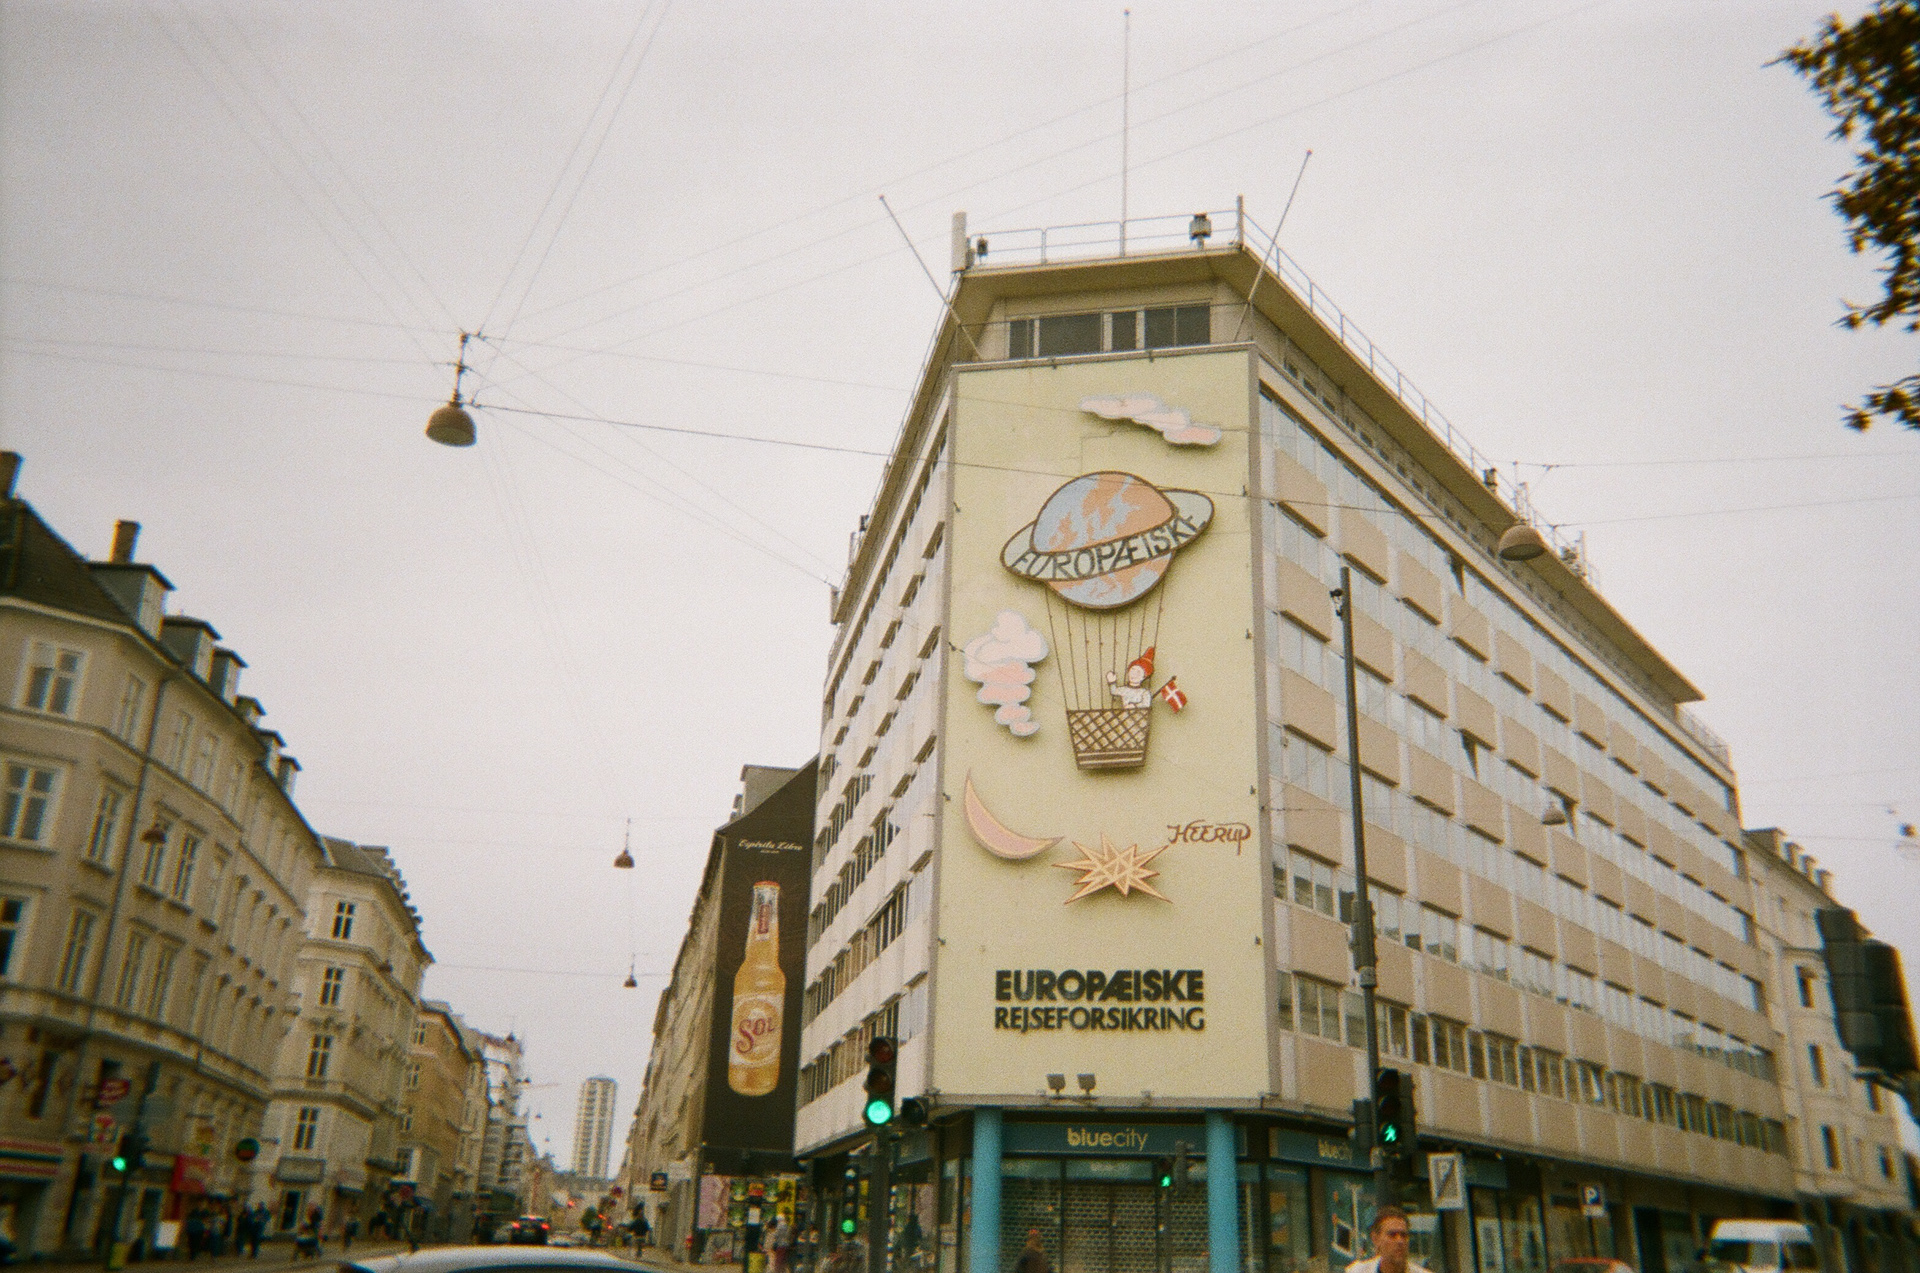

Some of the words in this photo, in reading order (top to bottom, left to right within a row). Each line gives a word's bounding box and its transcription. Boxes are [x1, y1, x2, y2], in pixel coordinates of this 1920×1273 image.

[1010, 514, 1206, 580] EUROPÆISKE
[1167, 819, 1251, 856] HEERUP
[995, 969, 1204, 1001] EUROPÆISKE
[994, 1006, 1205, 1033] REJSEFORSIKRING
[1067, 1127, 1149, 1151] bluecity
